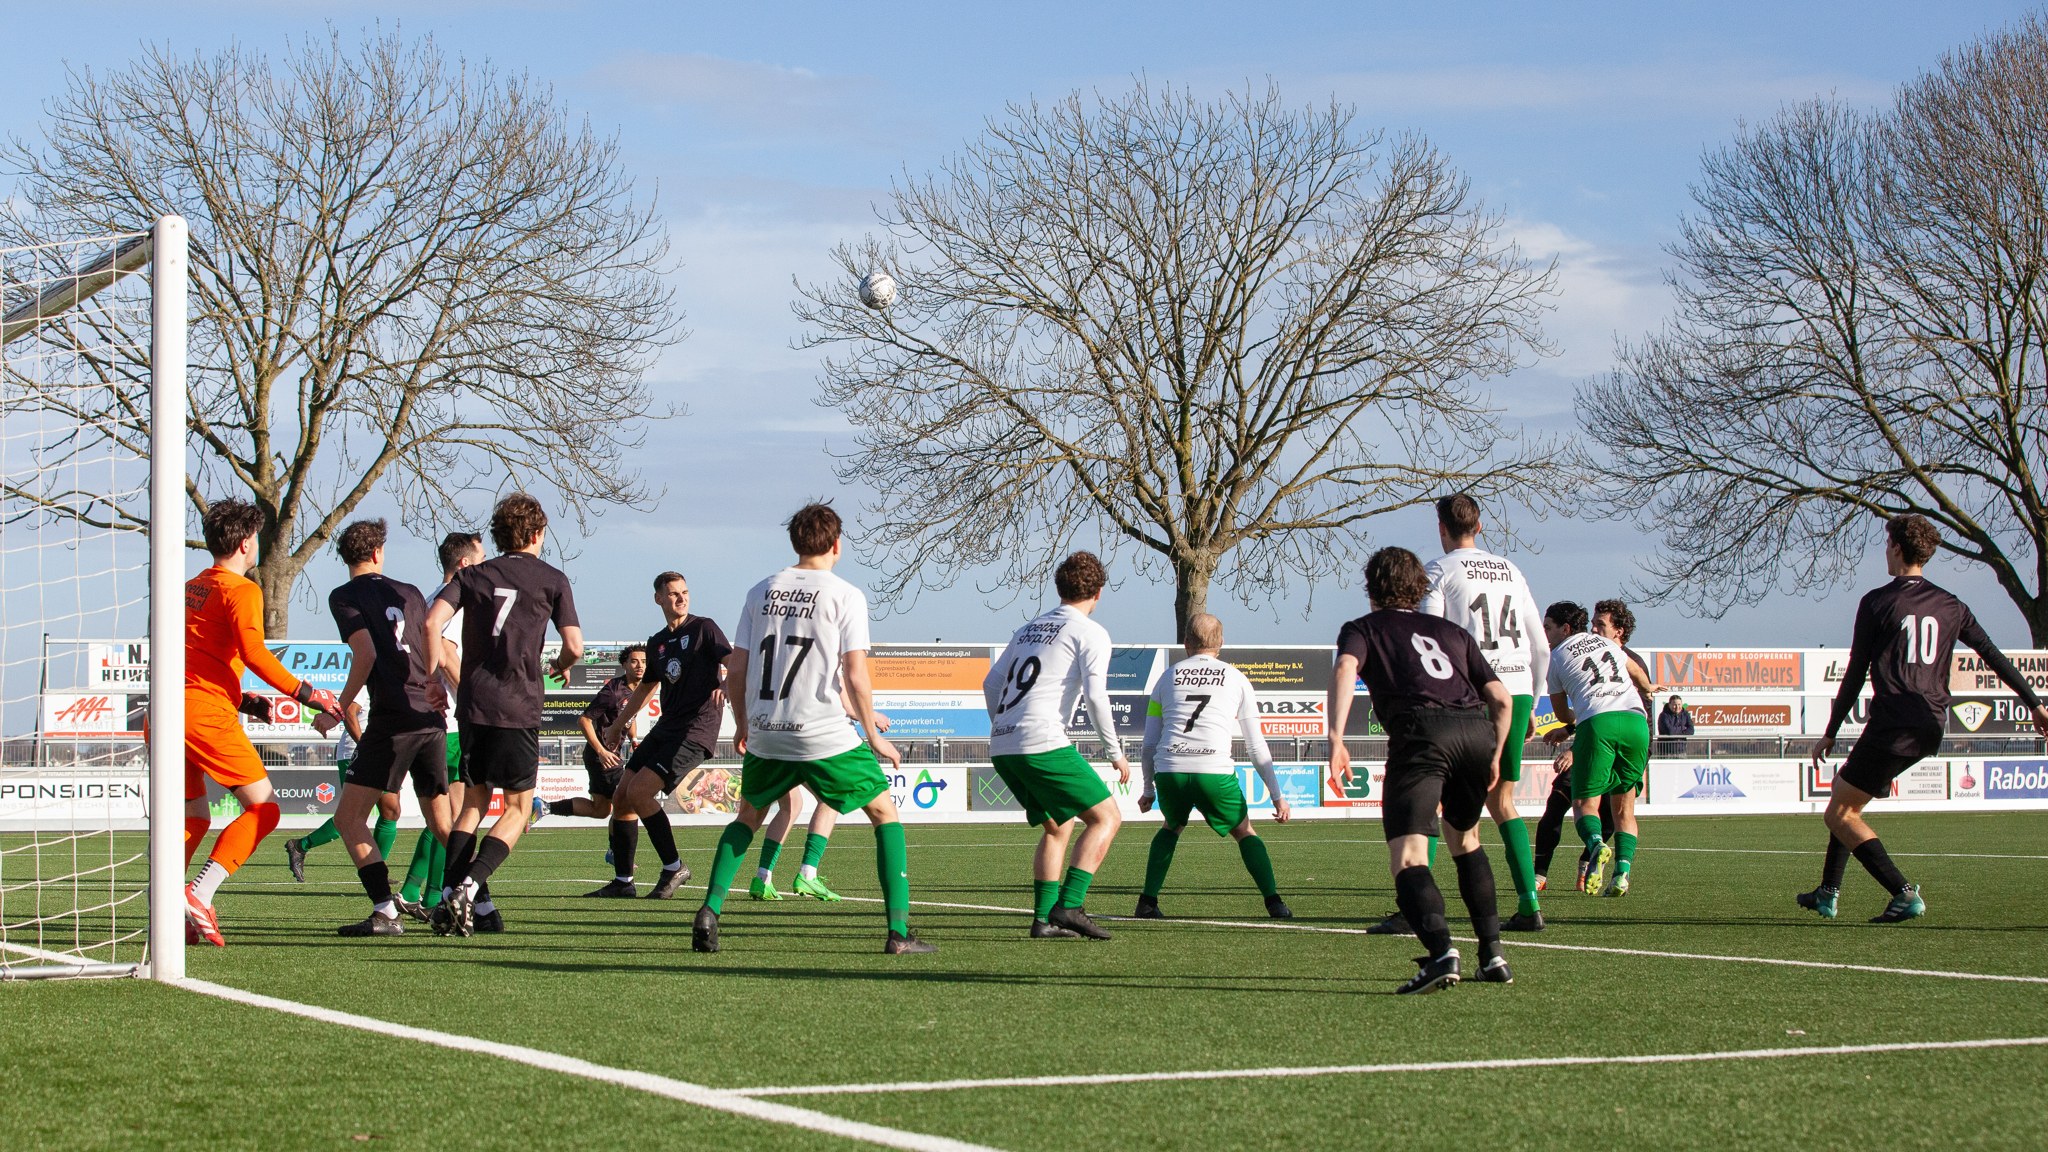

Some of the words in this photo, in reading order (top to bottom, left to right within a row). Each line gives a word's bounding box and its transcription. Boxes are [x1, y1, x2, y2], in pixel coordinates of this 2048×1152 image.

[1461, 559, 1509, 571] voetbal
[1467, 568, 1513, 583] shop.nl
[764, 588, 820, 605] voetbal
[492, 587, 518, 637] 7
[761, 603, 817, 620] shop.nl
[385, 606, 412, 654] 2
[1469, 592, 1522, 651] 14
[1017, 633, 1059, 646] shop.nl
[1900, 614, 1939, 665] 10
[875, 650, 971, 658] www.vleesbewerkingvanderpijl.nl
[1411, 632, 1454, 680] 8
[1697, 652, 1723, 660] GROND
[1726, 652, 1736, 660] EN
[1740, 652, 1793, 660] SLOOPWERKEN
[759, 633, 815, 701] 17
[1175, 667, 1225, 677] voetbal
[1274, 662, 1291, 670] Berry
[1581, 650, 1624, 687] 11
[1715, 666, 1742, 684] van
[1746, 661, 1794, 684] Meurs
[1174, 675, 1226, 688] shop.nl
[1975, 674, 2002, 689] PIET
[886, 700, 907, 708] Steegt
[908, 700, 950, 708] Sloopwerken
[1183, 694, 1212, 734] 7
[1688, 706, 1711, 724] Het
[1713, 706, 1786, 724] Zwaluwnest
[247, 724, 346, 732] GROOTHADE
[1263, 723, 1320, 734] VERHUUR
[1693, 768, 1732, 786] Vink
